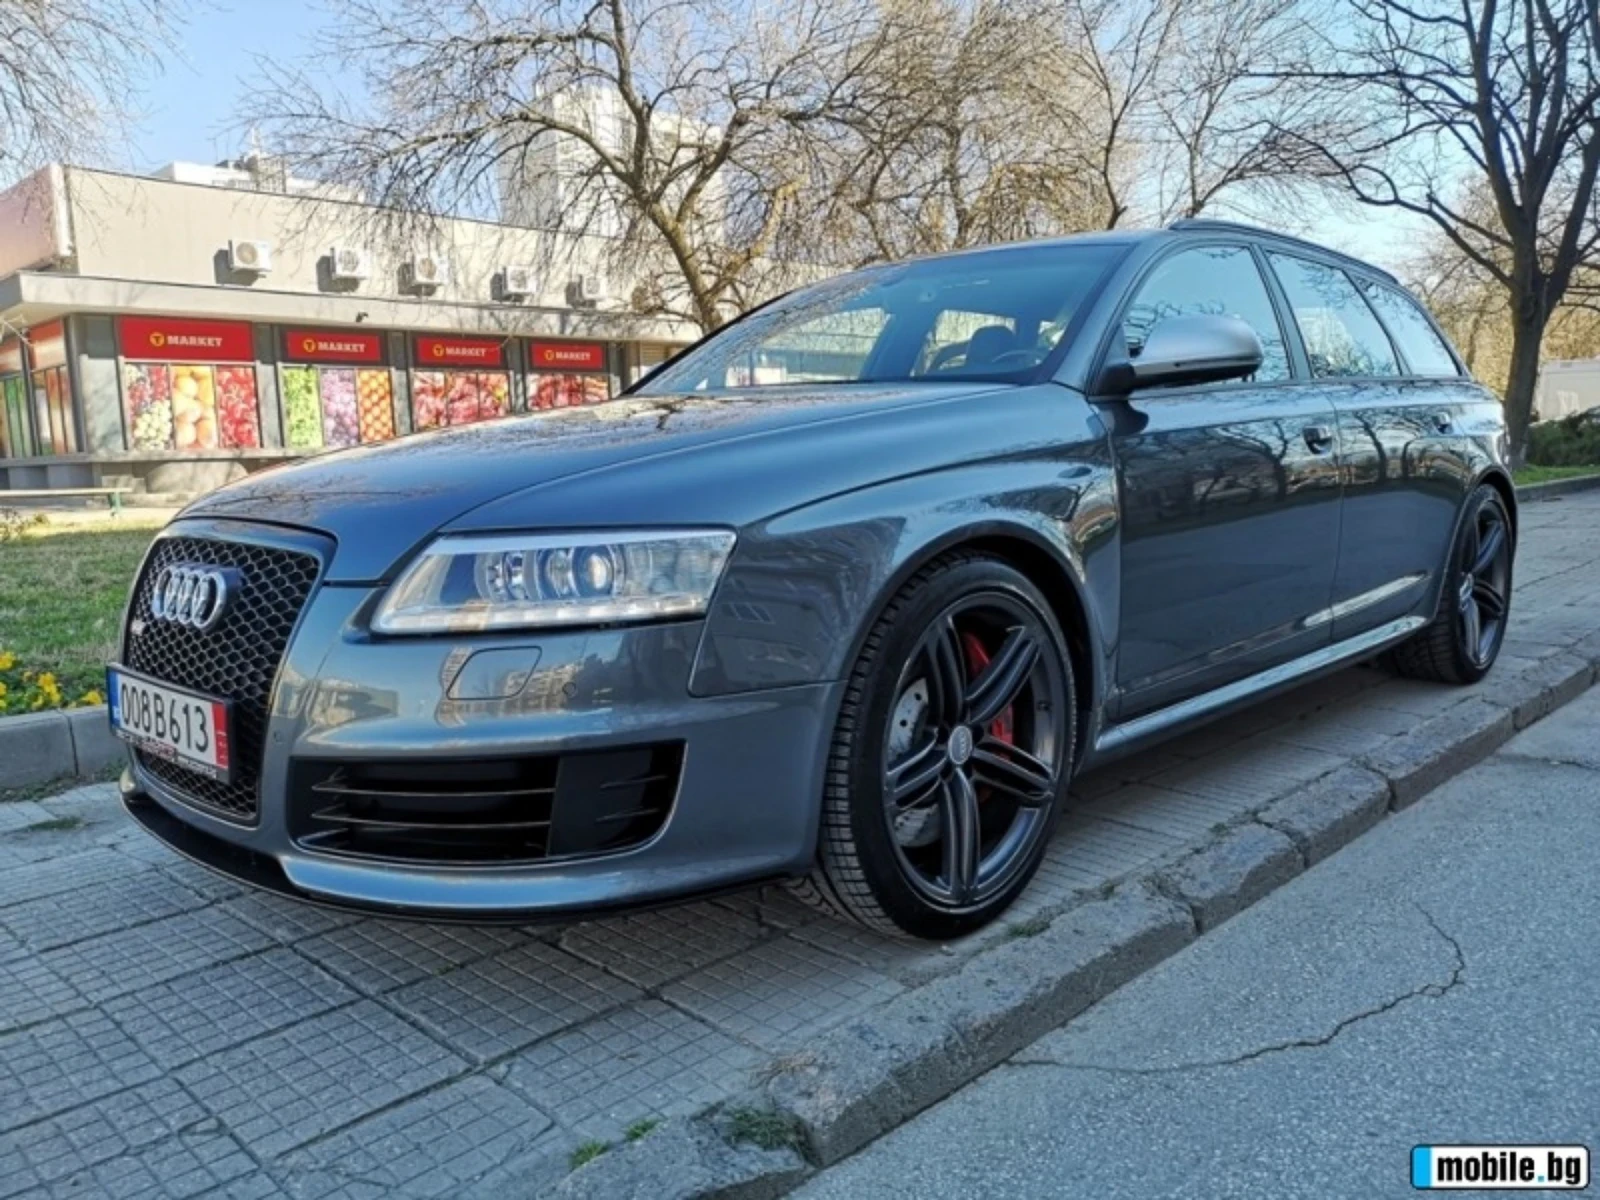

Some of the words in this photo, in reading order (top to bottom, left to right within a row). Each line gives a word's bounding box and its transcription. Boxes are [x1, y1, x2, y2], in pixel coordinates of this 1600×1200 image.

[167, 335, 222, 346] MARKET
[317, 341, 365, 353] MARKET
[445, 347, 486, 357] MARKET
